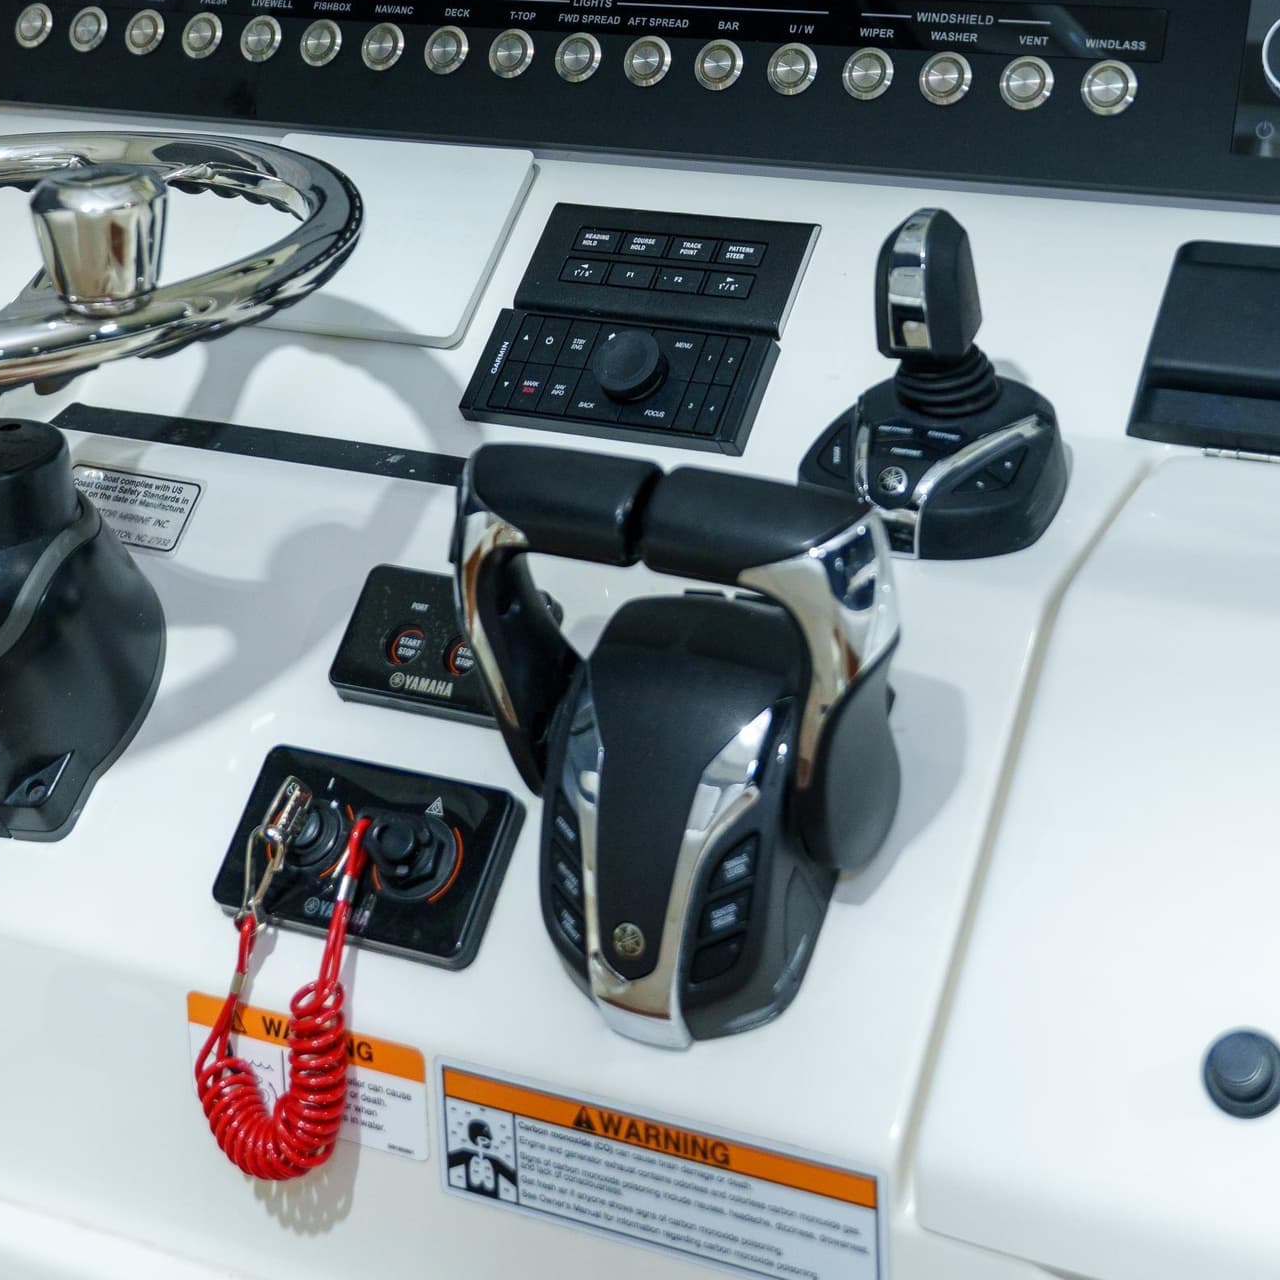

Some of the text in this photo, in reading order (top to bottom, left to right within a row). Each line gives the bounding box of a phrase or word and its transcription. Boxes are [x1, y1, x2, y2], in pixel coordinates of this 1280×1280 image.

[252, 0, 293, 8] LIVEWELL
[314, 2, 351, 11] FISHBOX
[375, 5, 414, 14] NAV/ANC
[445, 8, 470, 17] DECK
[559, 14, 621, 24] FWD SPREAD
[628, 17, 689, 28] AFT SPREAD
[917, 12, 994, 25] WINDSHIELD
[718, 22, 739, 30] BAR
[860, 28, 894, 38] WIPER
[931, 32, 978, 42] WASHER
[1020, 36, 1048, 46] VENT
[1086, 39, 1146, 50] WINDLASS
[491, 341, 509, 374] GARMIN
[103, 474, 183, 494] boat complies with US
[74, 478, 93, 488] Coast
[94, 481, 117, 492] Guard
[120, 486, 142, 497] Safety
[142, 490, 180, 503] Standards
[113, 495, 128, 503] date
[139, 500, 185, 514] Manufacture.
[400, 637, 421, 647] START
[398, 647, 415, 656] STOP
[458, 647, 472, 656] STA
[456, 658, 473, 666] STOP
[404, 675, 453, 696] YAMAHA
[368, 1083, 412, 1100] can cause
[361, 1093, 386, 1107] death.
[354, 1105, 377, 1116] when
[361, 1121, 385, 1131] water.
[598, 1111, 730, 1165] WARNING
